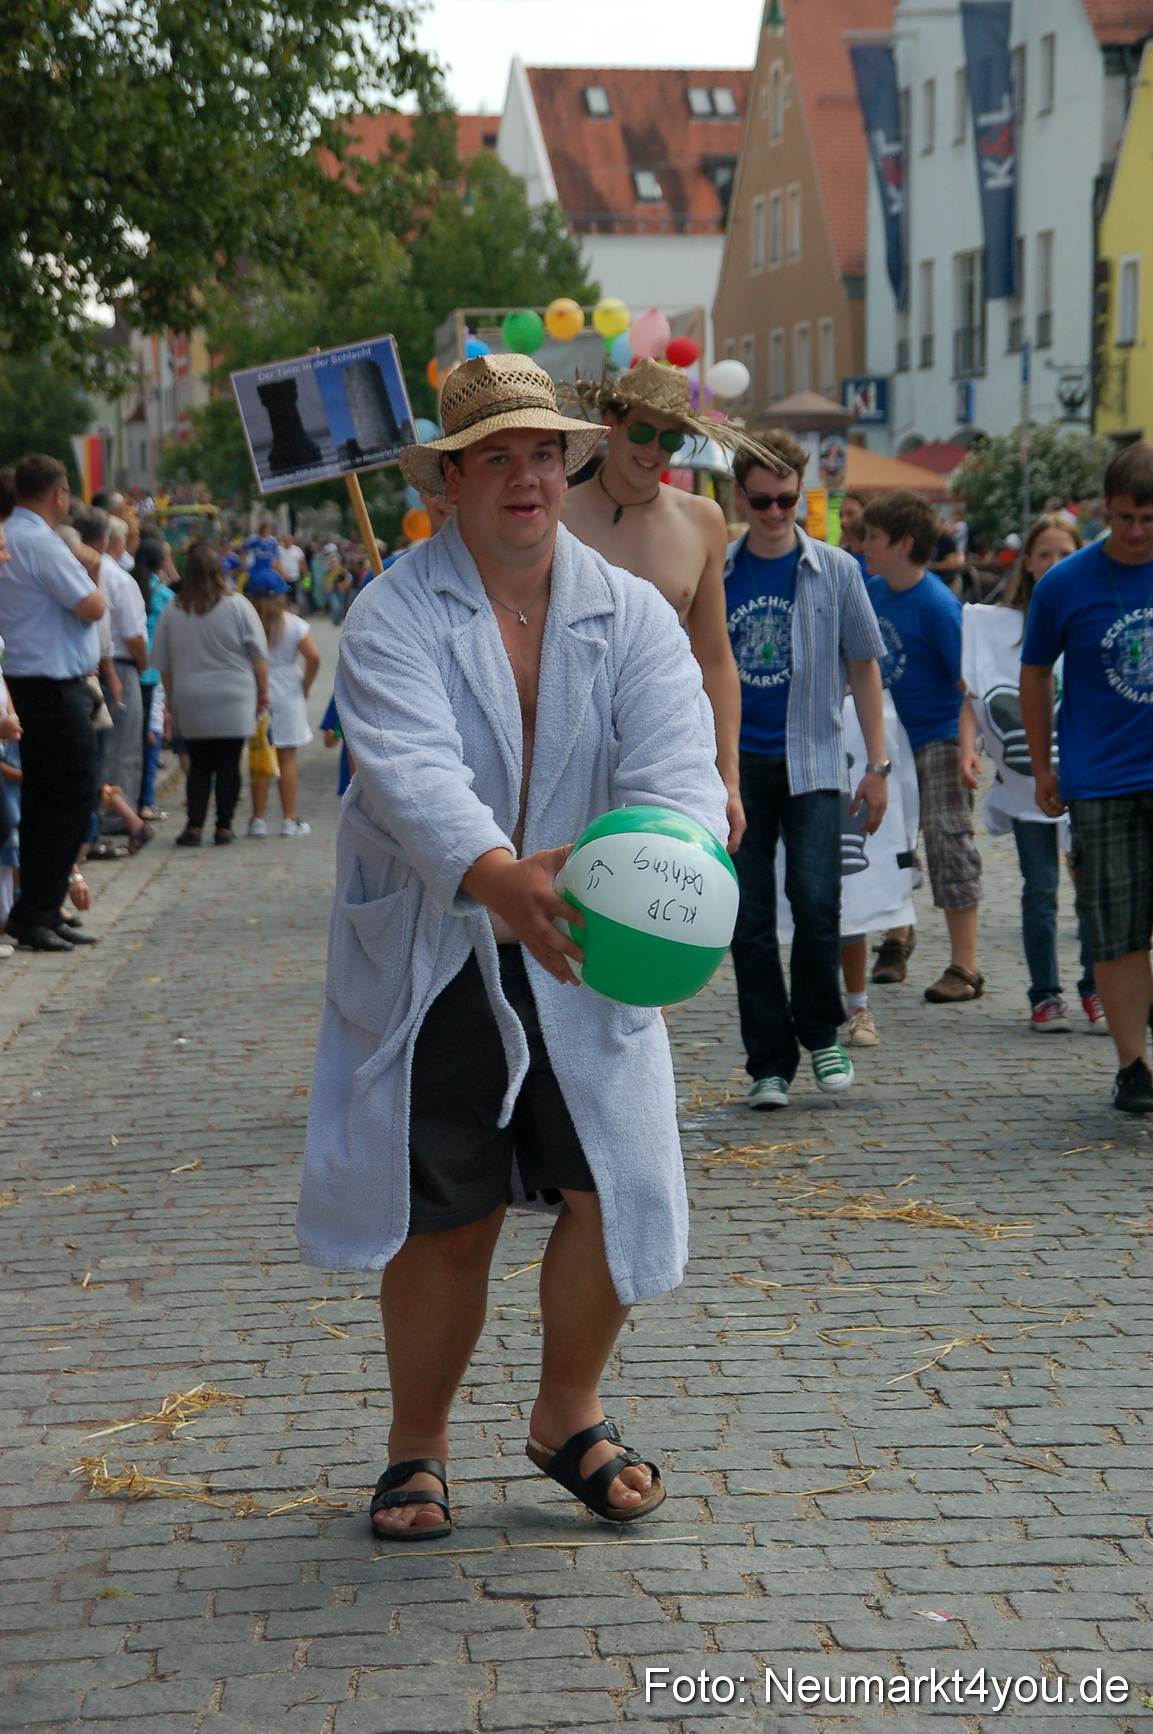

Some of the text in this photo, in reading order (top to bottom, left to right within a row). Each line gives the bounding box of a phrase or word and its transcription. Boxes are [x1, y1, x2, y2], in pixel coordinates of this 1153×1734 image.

[258, 370, 274, 382] Der
[277, 364, 301, 377] Turm
[314, 355, 329, 369] der
[331, 346, 372, 366] Schlacht
[738, 663, 791, 688] MARKT
